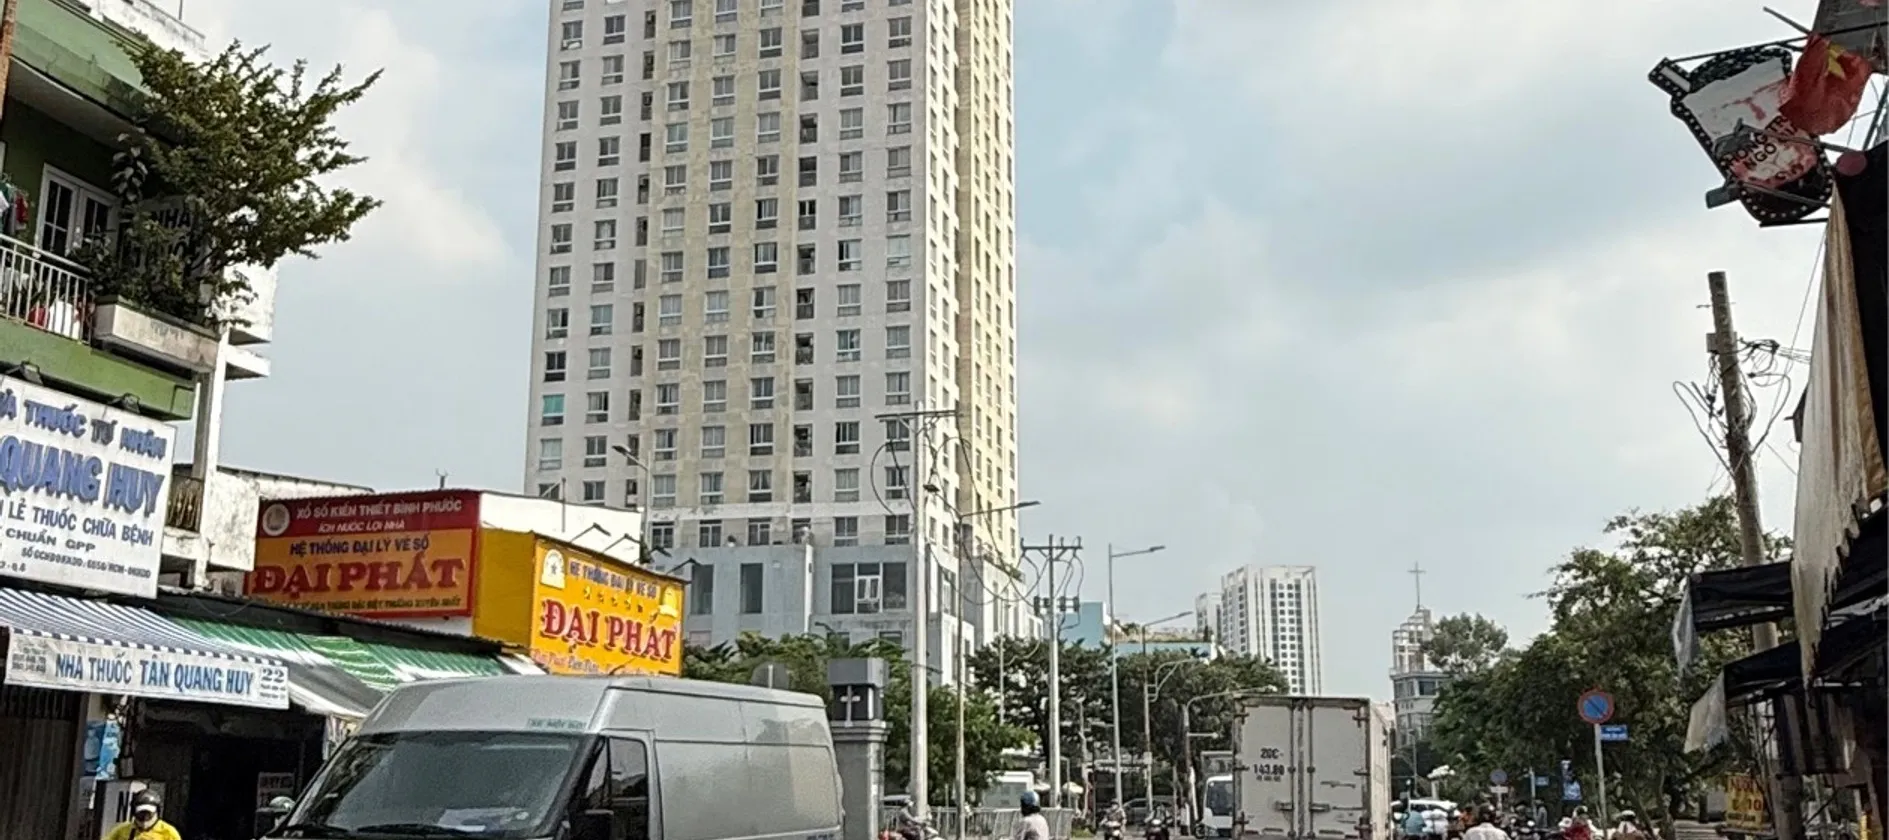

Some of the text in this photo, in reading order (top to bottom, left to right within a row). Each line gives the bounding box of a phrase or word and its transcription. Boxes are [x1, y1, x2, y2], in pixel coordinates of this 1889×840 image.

[24, 400, 87, 438] THUỐC
[91, 418, 118, 446] TƯ
[120, 427, 167, 460] NHÂN
[0, 435, 165, 518] QUANG HUY
[8, 498, 26, 521] LẺ
[32, 507, 77, 531] THUỐC
[83, 517, 116, 539] CHỮA
[122, 524, 154, 546] BỆNH
[313, 501, 329, 518] SỐ
[330, 501, 357, 517] KIẾN
[359, 500, 392, 516] THIẾT
[393, 499, 420, 514] BÌNH
[422, 497, 462, 513] PHƯỚC
[318, 520, 335, 533] ÍCH
[6, 528, 96, 552] CHUẨN GPP
[289, 532, 430, 557] HỆ THỐNG ĐẠI LÝ VÉ SỐ
[252, 551, 465, 599] ĐẠI PHÁT
[541, 599, 600, 653] ĐẠI
[605, 611, 677, 663] PHÁT
[55, 648, 84, 679] NHÀ
[88, 651, 132, 685] THUỐC
[140, 653, 170, 687] TÂN
[174, 663, 223, 692] QUANG
[226, 669, 254, 695] HUY
[263, 667, 285, 684] 22
